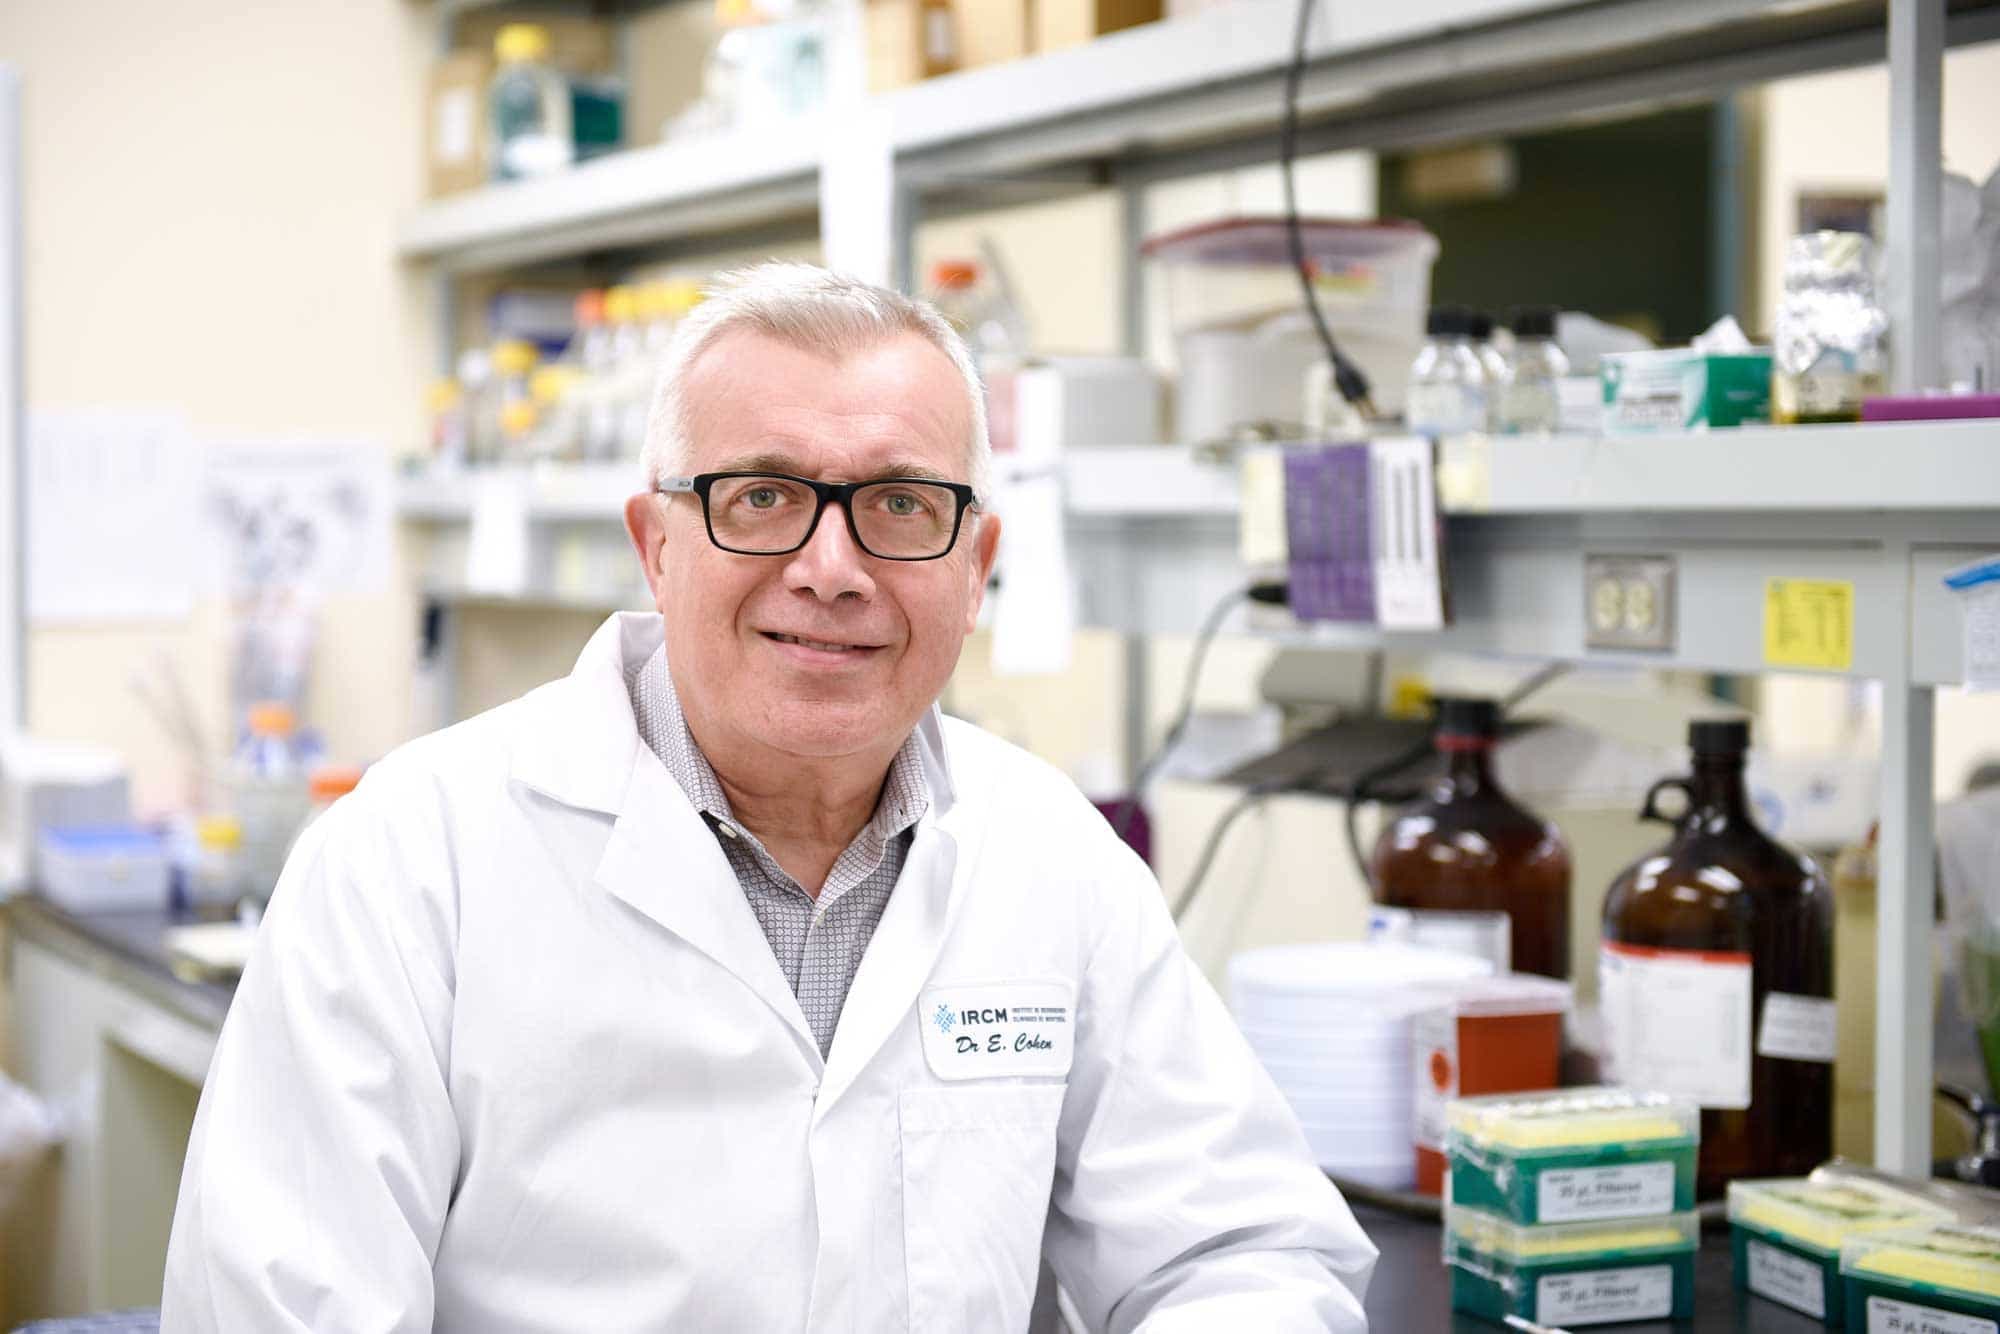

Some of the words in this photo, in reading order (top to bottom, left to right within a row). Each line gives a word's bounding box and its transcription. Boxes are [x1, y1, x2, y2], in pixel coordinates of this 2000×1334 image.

[961, 1008, 1008, 1025] IRCM
[956, 1036, 979, 1054] Dr
[987, 1034, 1007, 1053] E.
[1014, 1032, 1053, 1052] Cohen
